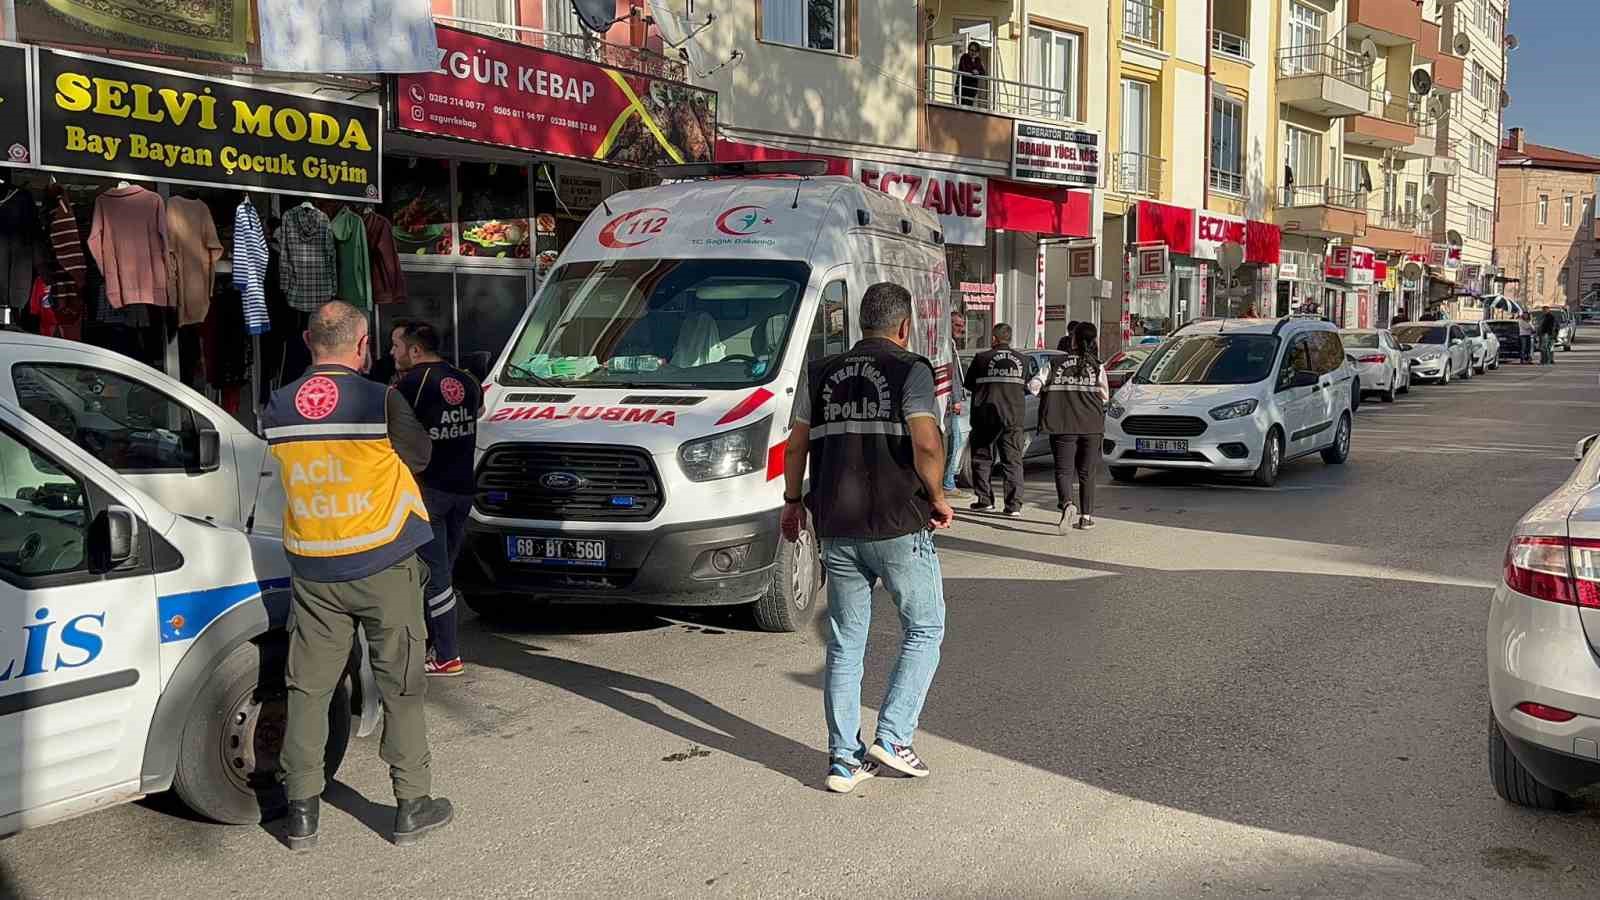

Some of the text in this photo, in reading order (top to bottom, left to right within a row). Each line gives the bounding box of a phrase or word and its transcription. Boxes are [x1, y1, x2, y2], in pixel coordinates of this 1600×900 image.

[436, 48, 596, 104] ZGÜR KEBAP
[55, 72, 372, 151] SELVİ MODA
[449, 97, 464, 107] 214
[476, 102, 486, 111] 77
[65, 125, 369, 185] Bay Bayan Çocuk Giyim
[861, 168, 983, 218] ECZANE
[627, 216, 668, 235] 112
[993, 367, 1019, 377] POLİS
[1061, 375, 1090, 386] POLİS
[441, 405, 474, 424] ACİL
[829, 397, 878, 420] POLİS
[1174, 440, 1187, 450] 192
[290, 452, 352, 486] ACİL
[517, 539, 603, 559] 68 BT 560
